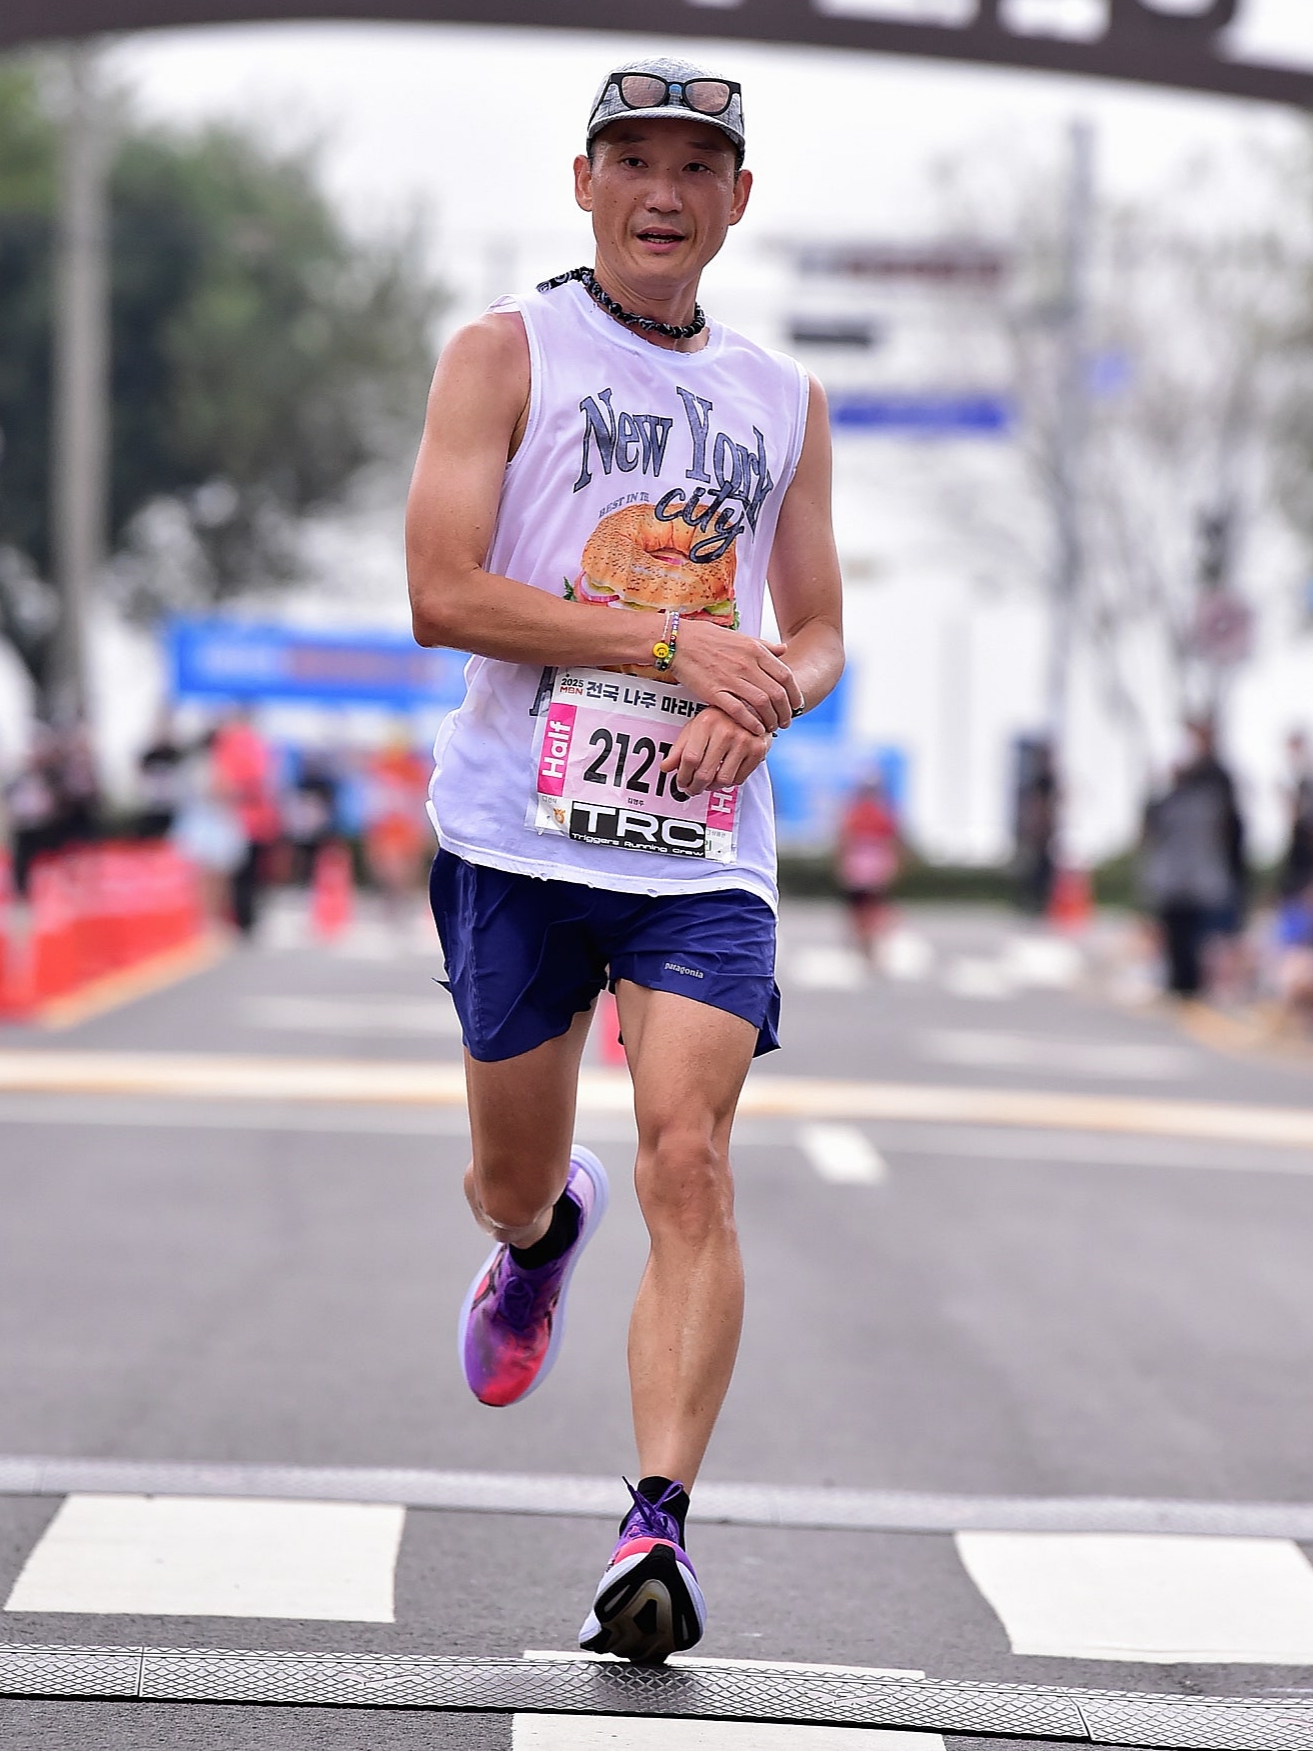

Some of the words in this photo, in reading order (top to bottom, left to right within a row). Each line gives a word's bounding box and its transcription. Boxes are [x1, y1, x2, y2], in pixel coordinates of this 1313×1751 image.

[573, 388, 673, 493] New
[676, 386, 774, 541] York
[598, 496, 625, 519] BEST
[626, 492, 639, 504] IN
[654, 486, 745, 564] city
[559, 686, 584, 695] MBN
[561, 678, 584, 688] 2025
[586, 681, 620, 702] 전국
[623, 688, 657, 709] 나주
[541, 720, 571, 779] Half
[572, 802, 705, 849] TRC
[571, 832, 620, 846] Triggers
[623, 841, 668, 853] Running
[672, 848, 704, 857] Crew
[664, 962, 704, 979] patagonia
